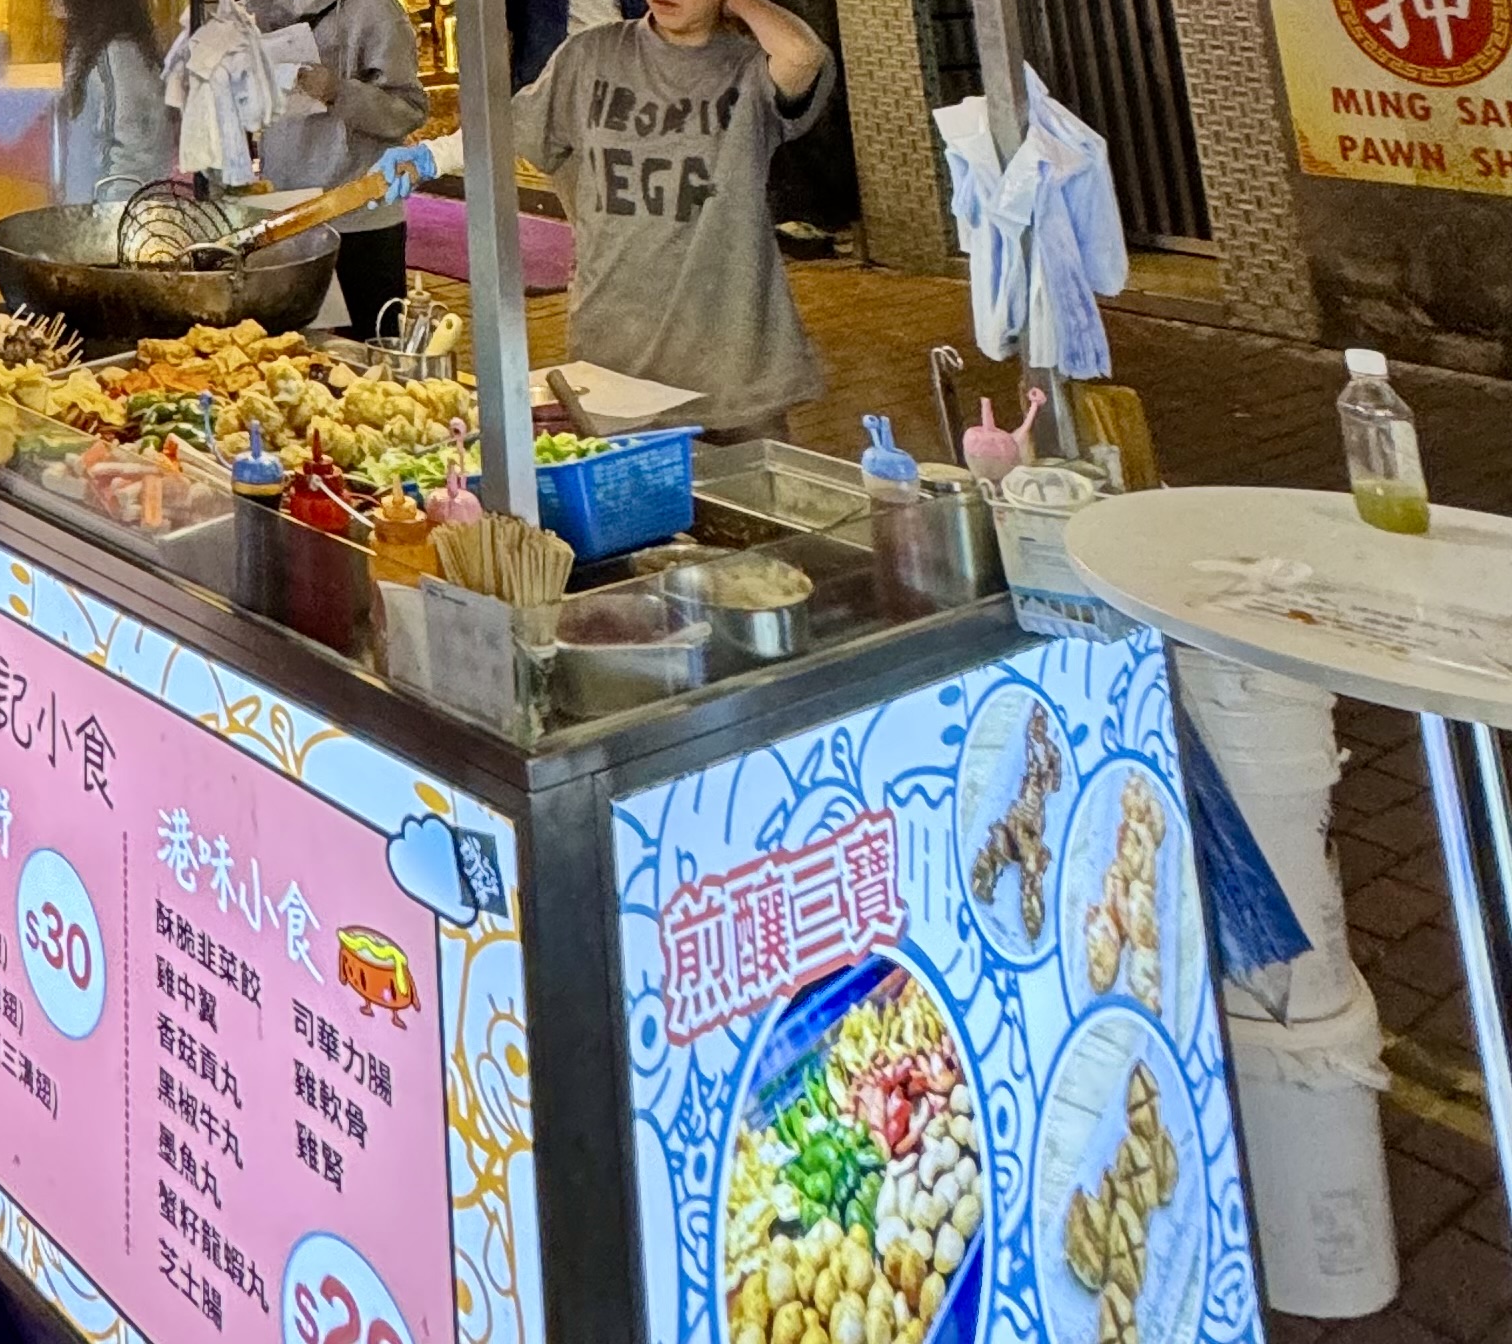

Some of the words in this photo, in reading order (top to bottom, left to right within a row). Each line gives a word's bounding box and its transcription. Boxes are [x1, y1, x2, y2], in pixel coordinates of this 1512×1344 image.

[1331, 86, 1434, 122] MING
[1456, 96, 1512, 129] SA
[1338, 134, 1447, 173] PAWN
[157, 808, 325, 985] 港味小食
[662, 815, 906, 1035] 煎釀三寶
[26, 901, 92, 991] $30
[155, 898, 262, 1009] 酥脆韭菜餃
[155, 953, 218, 1034] 雞中翼
[157, 1011, 243, 1109] 香菇貢丸
[291, 997, 392, 1108] 司華力腸
[158, 1066, 243, 1170] 黑椒牛丸
[293, 1058, 368, 1149] 雞軟骨
[158, 1122, 222, 1210] 墨魚丸
[159, 1179, 270, 1314] 蟹籽龍蝦丸
[159, 1238, 223, 1332] 芝士腸
